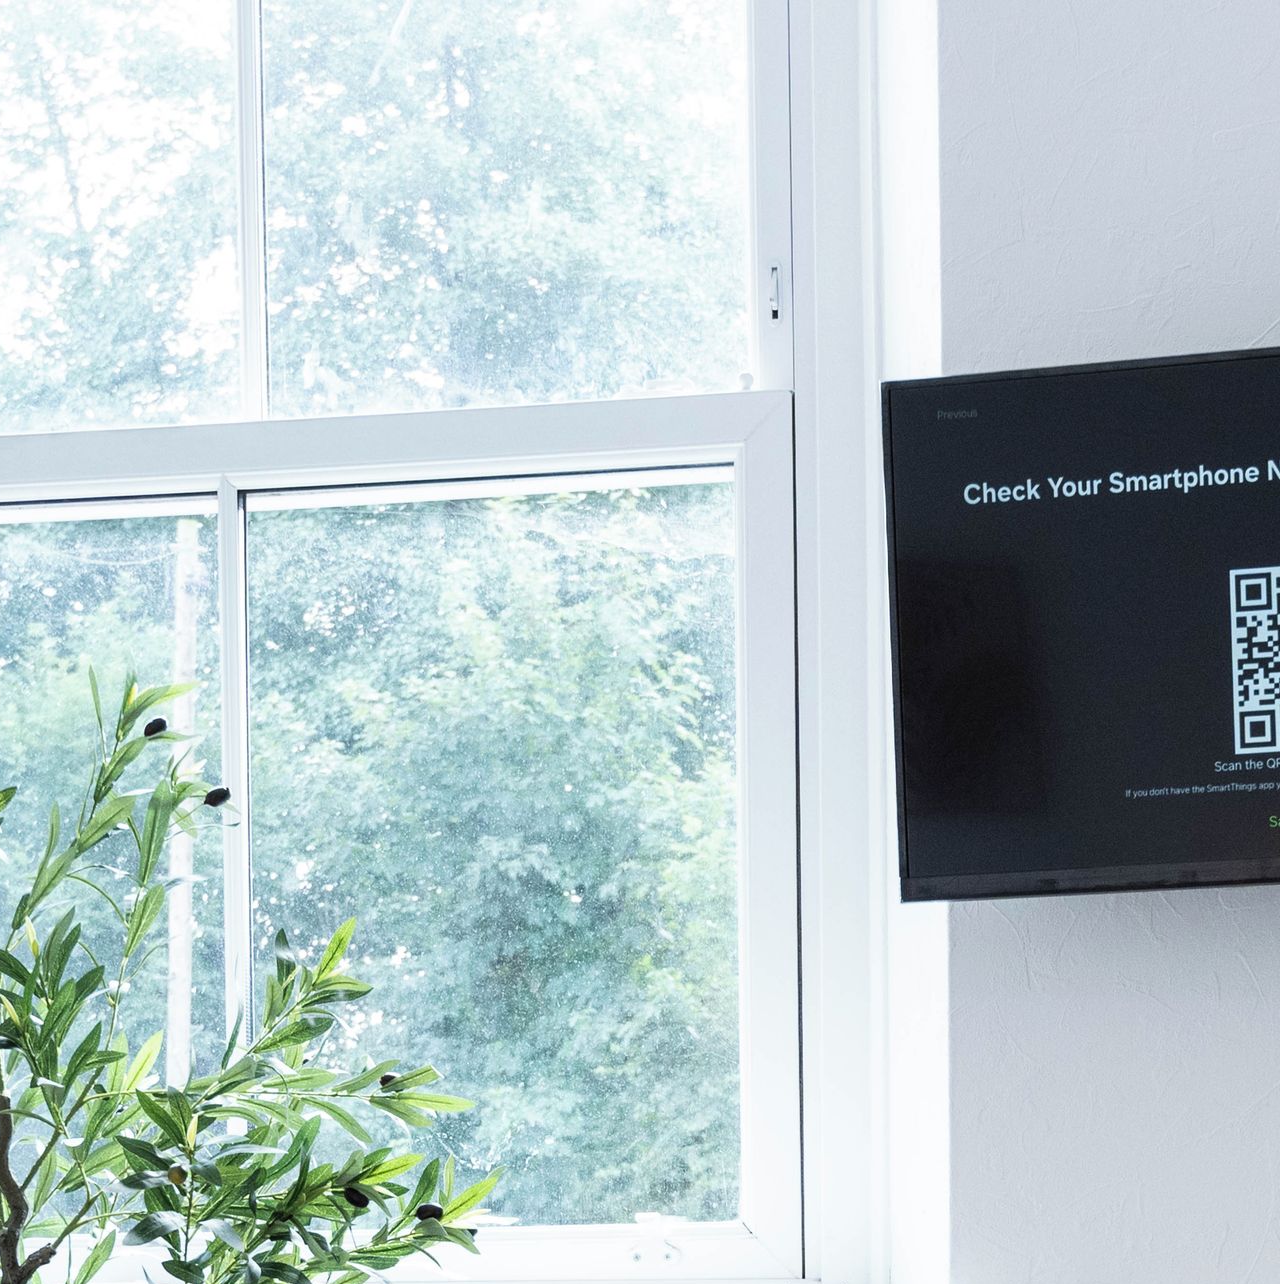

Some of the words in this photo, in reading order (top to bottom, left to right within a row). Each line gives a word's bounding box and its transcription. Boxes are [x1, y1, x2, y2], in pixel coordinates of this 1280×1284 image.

[936, 408, 978, 421] Previous
[963, 478, 1041, 505] Check
[1047, 476, 1103, 498] Your
[1108, 464, 1260, 494] Smartphone
[1214, 760, 1243, 773] Scan
[1244, 759, 1264, 771] the
[1125, 789, 1132, 798] If
[1132, 788, 1149, 800] you
[1170, 786, 1191, 796] have
[1191, 785, 1206, 794] the
[1206, 782, 1258, 794] SmartThings
[1258, 782, 1275, 792] app
